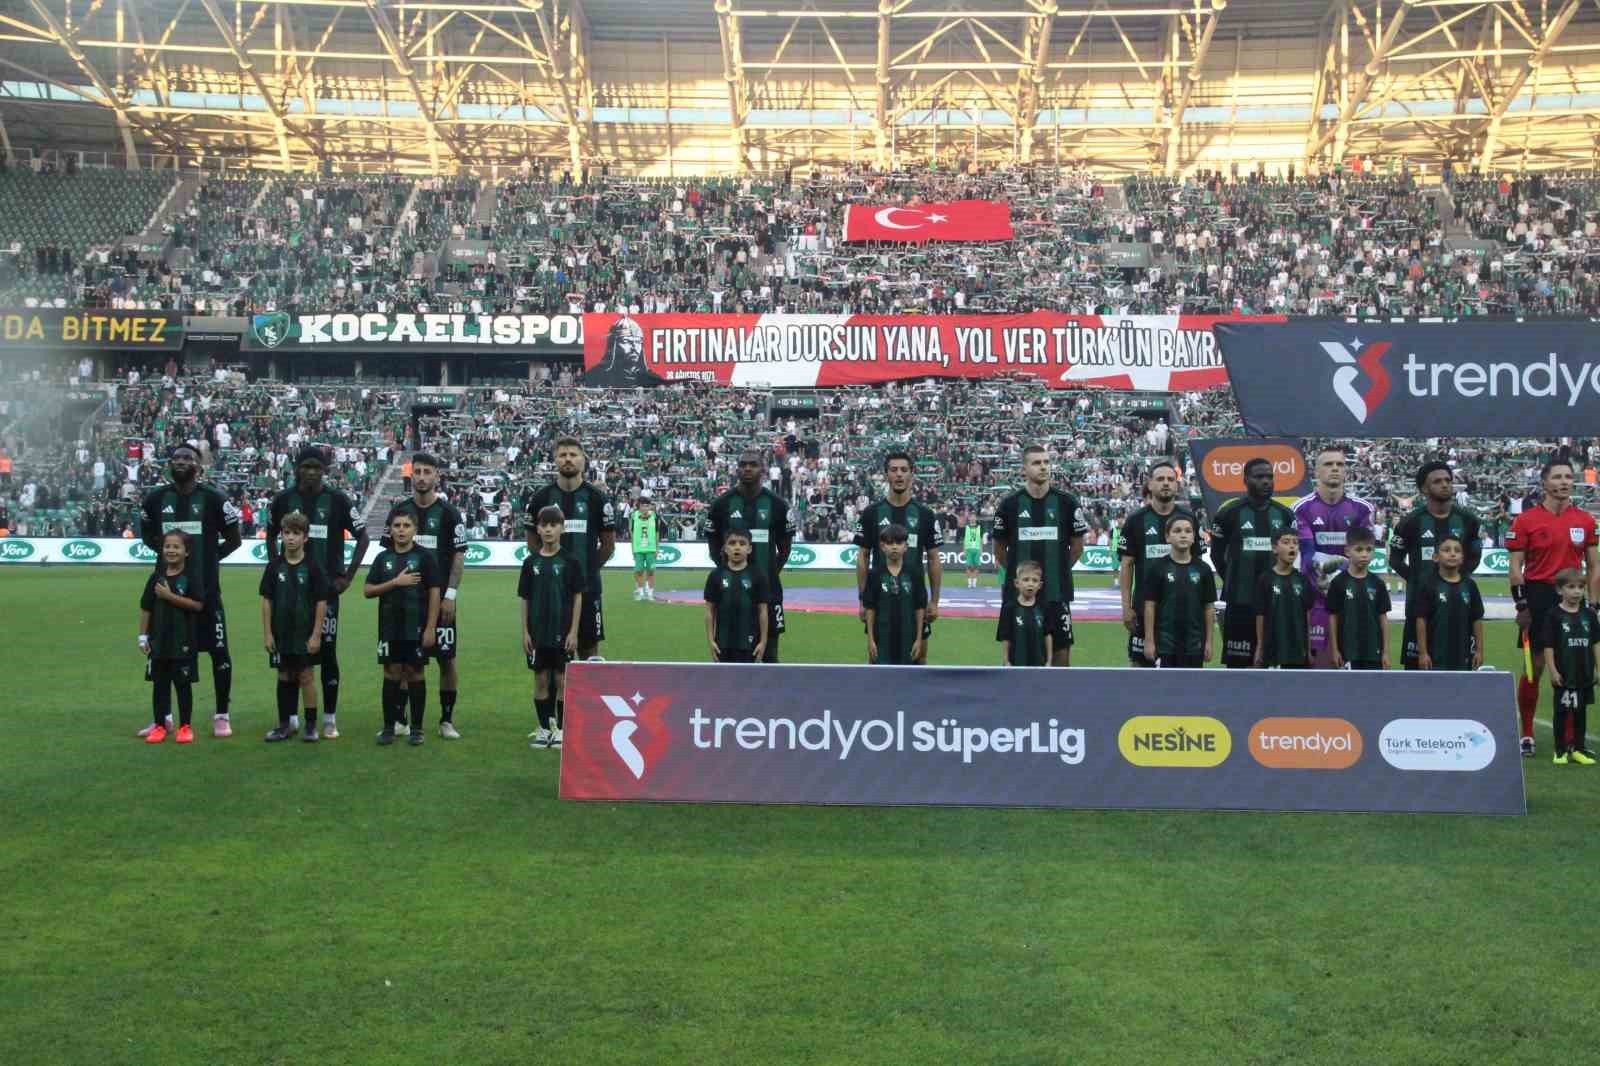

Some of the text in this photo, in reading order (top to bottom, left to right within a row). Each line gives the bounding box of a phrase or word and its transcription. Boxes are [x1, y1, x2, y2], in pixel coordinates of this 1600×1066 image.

[0, 312, 167, 342] DA BİTMEZ
[298, 311, 584, 344] KOCAELİSPO
[652, 326, 782, 363] FIRTINALAR
[787, 325, 877, 362] DURSUN
[883, 325, 949, 368] YANA,
[955, 327, 998, 363] YOL
[1003, 327, 1047, 364] VER
[1052, 320, 1150, 367] TÜRK'ÜN
[0, 543, 28, 557] Yöre
[68, 543, 95, 557] Yöre
[655, 551, 676, 560] öre
[215, 623, 224, 639] 5
[1560, 690, 1578, 708] 41
[689, 708, 1086, 765] trendyol SüperLig
[1259, 731, 1352, 753] trendyol
[1415, 736, 1466, 749] Telekom
